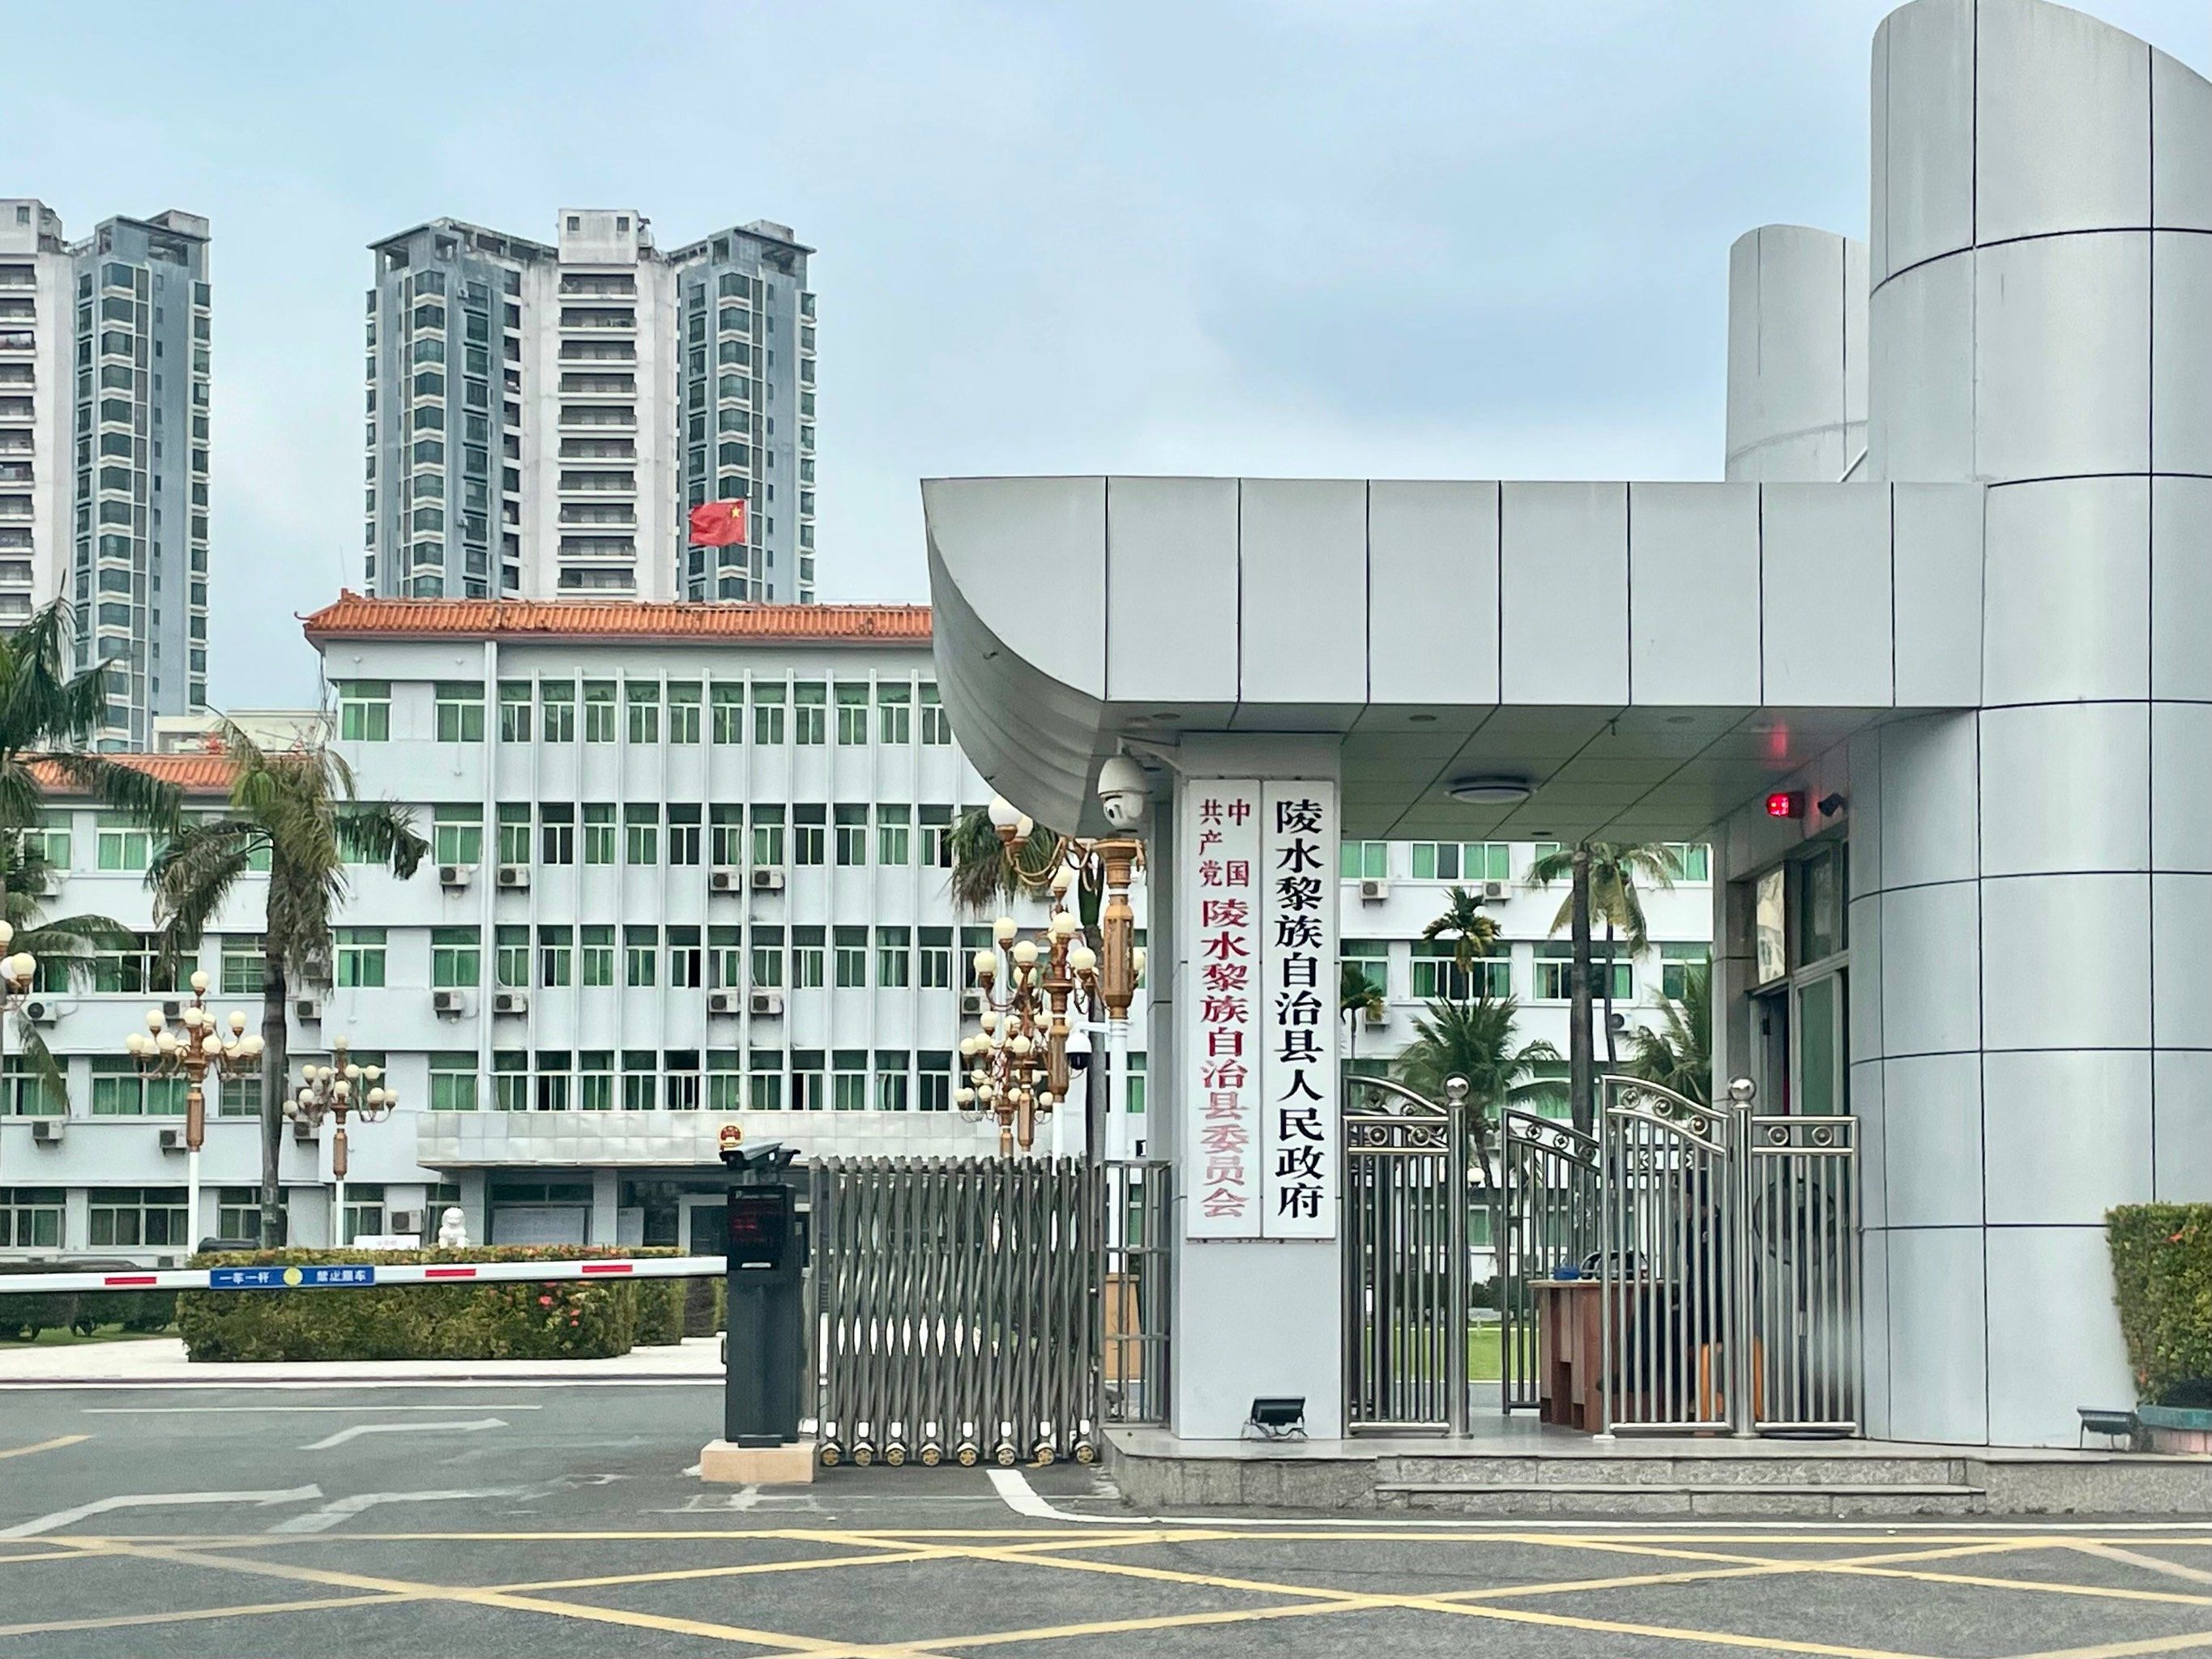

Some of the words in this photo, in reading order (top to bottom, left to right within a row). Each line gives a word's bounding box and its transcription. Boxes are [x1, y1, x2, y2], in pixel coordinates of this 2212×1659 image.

[1199, 898, 1250, 1218] 陵水黎族自治县委员会
[1274, 799, 1325, 1219] 陵水黎族自治县人民政府
